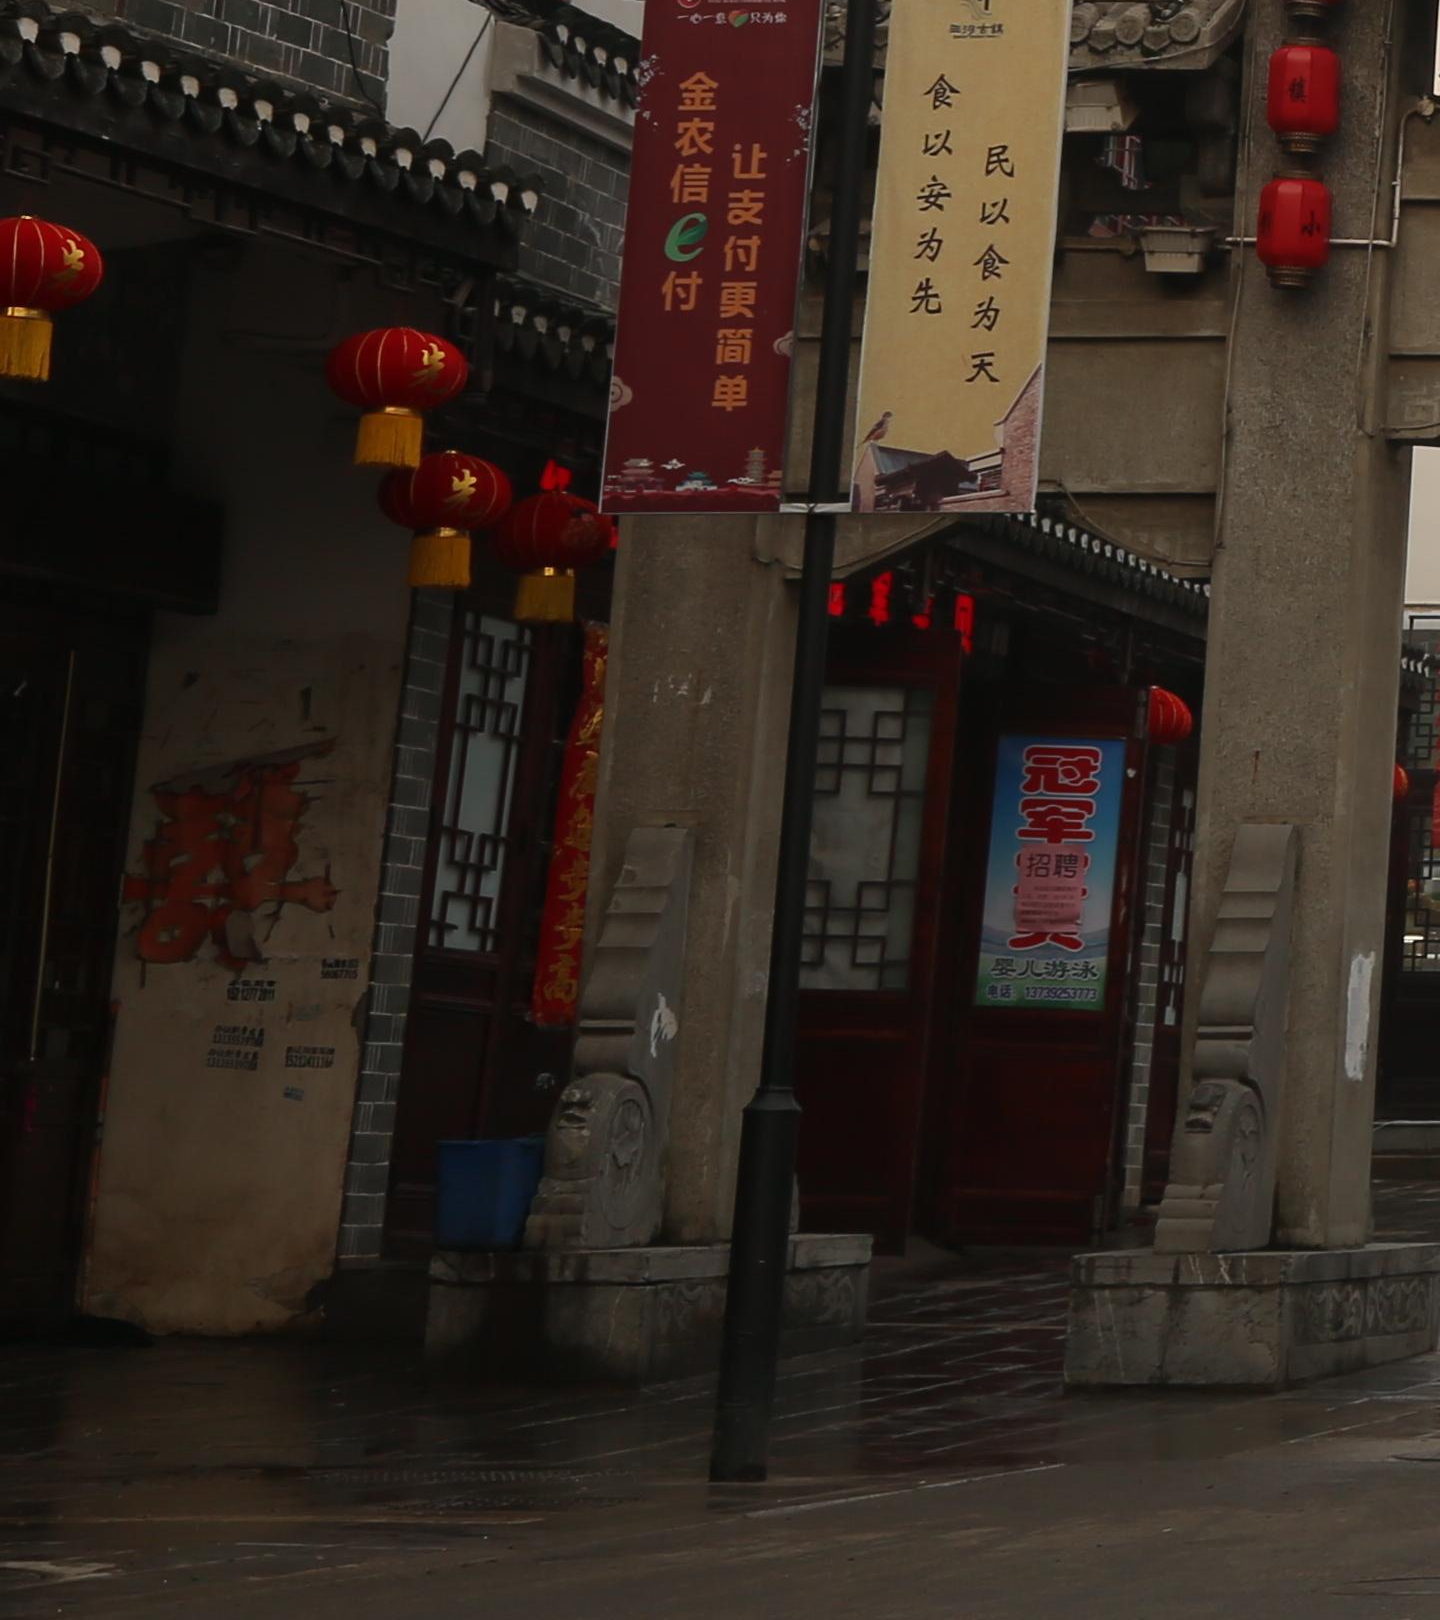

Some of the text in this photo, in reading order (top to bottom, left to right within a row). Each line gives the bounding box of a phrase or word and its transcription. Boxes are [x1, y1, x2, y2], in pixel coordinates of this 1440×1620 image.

[712, 143, 767, 411] 让支付更简单
[911, 74, 960, 315] 食以安为先
[964, 145, 1015, 383] 民以食为天
[991, 958, 1098, 980] 婴儿游泳
[1026, 853, 1079, 878] 招聘
